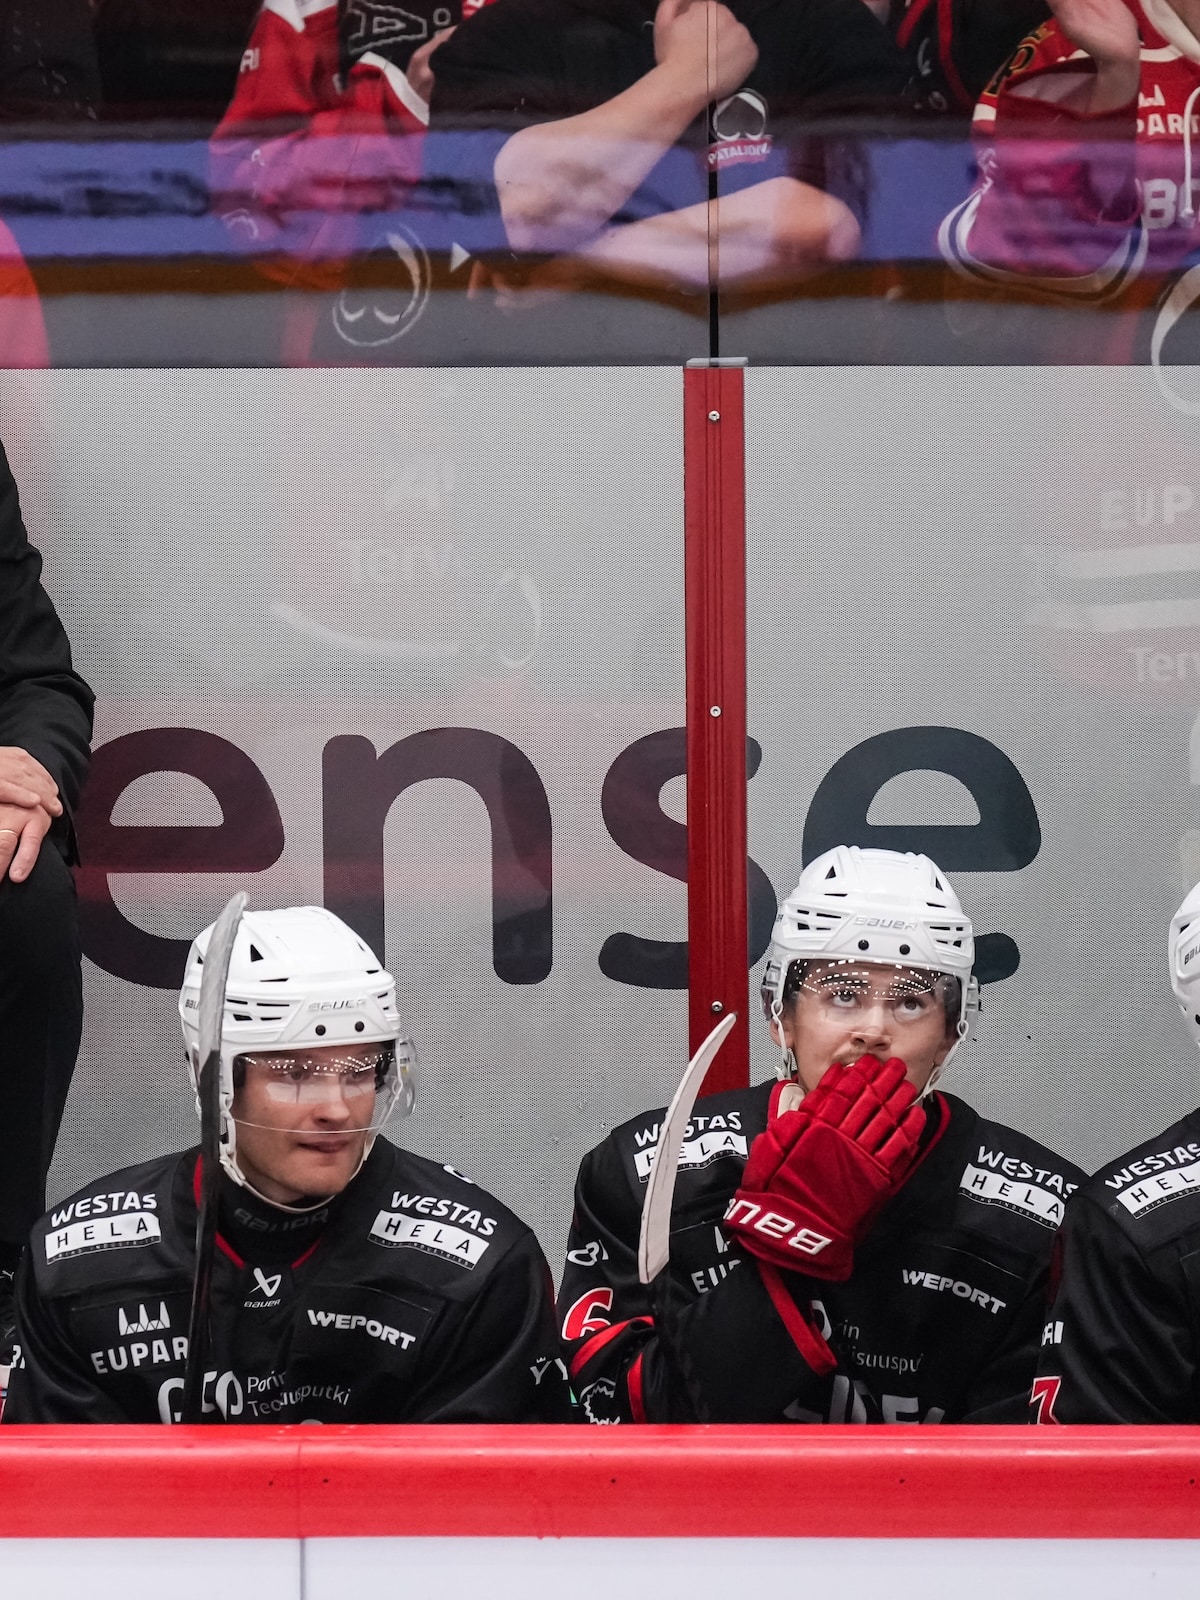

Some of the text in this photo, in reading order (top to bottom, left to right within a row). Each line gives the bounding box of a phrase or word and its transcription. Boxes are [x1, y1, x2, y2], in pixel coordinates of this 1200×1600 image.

[1098, 481, 1196, 533] EUP
[634, 1111, 742, 1147] WSTAS
[977, 1145, 1079, 1199] WESTAS
[1131, 1173, 1195, 1203] HEL
[50, 1191, 158, 1228] WESTAS
[389, 1190, 498, 1236] WESTAS
[971, 1173, 1060, 1218] HELA
[56, 1217, 149, 1249] HELA
[384, 1220, 471, 1255] HELA
[902, 1269, 1006, 1314] WEPORT
[307, 1309, 416, 1350] WEPORT
[90, 1336, 189, 1375] EUPAR
